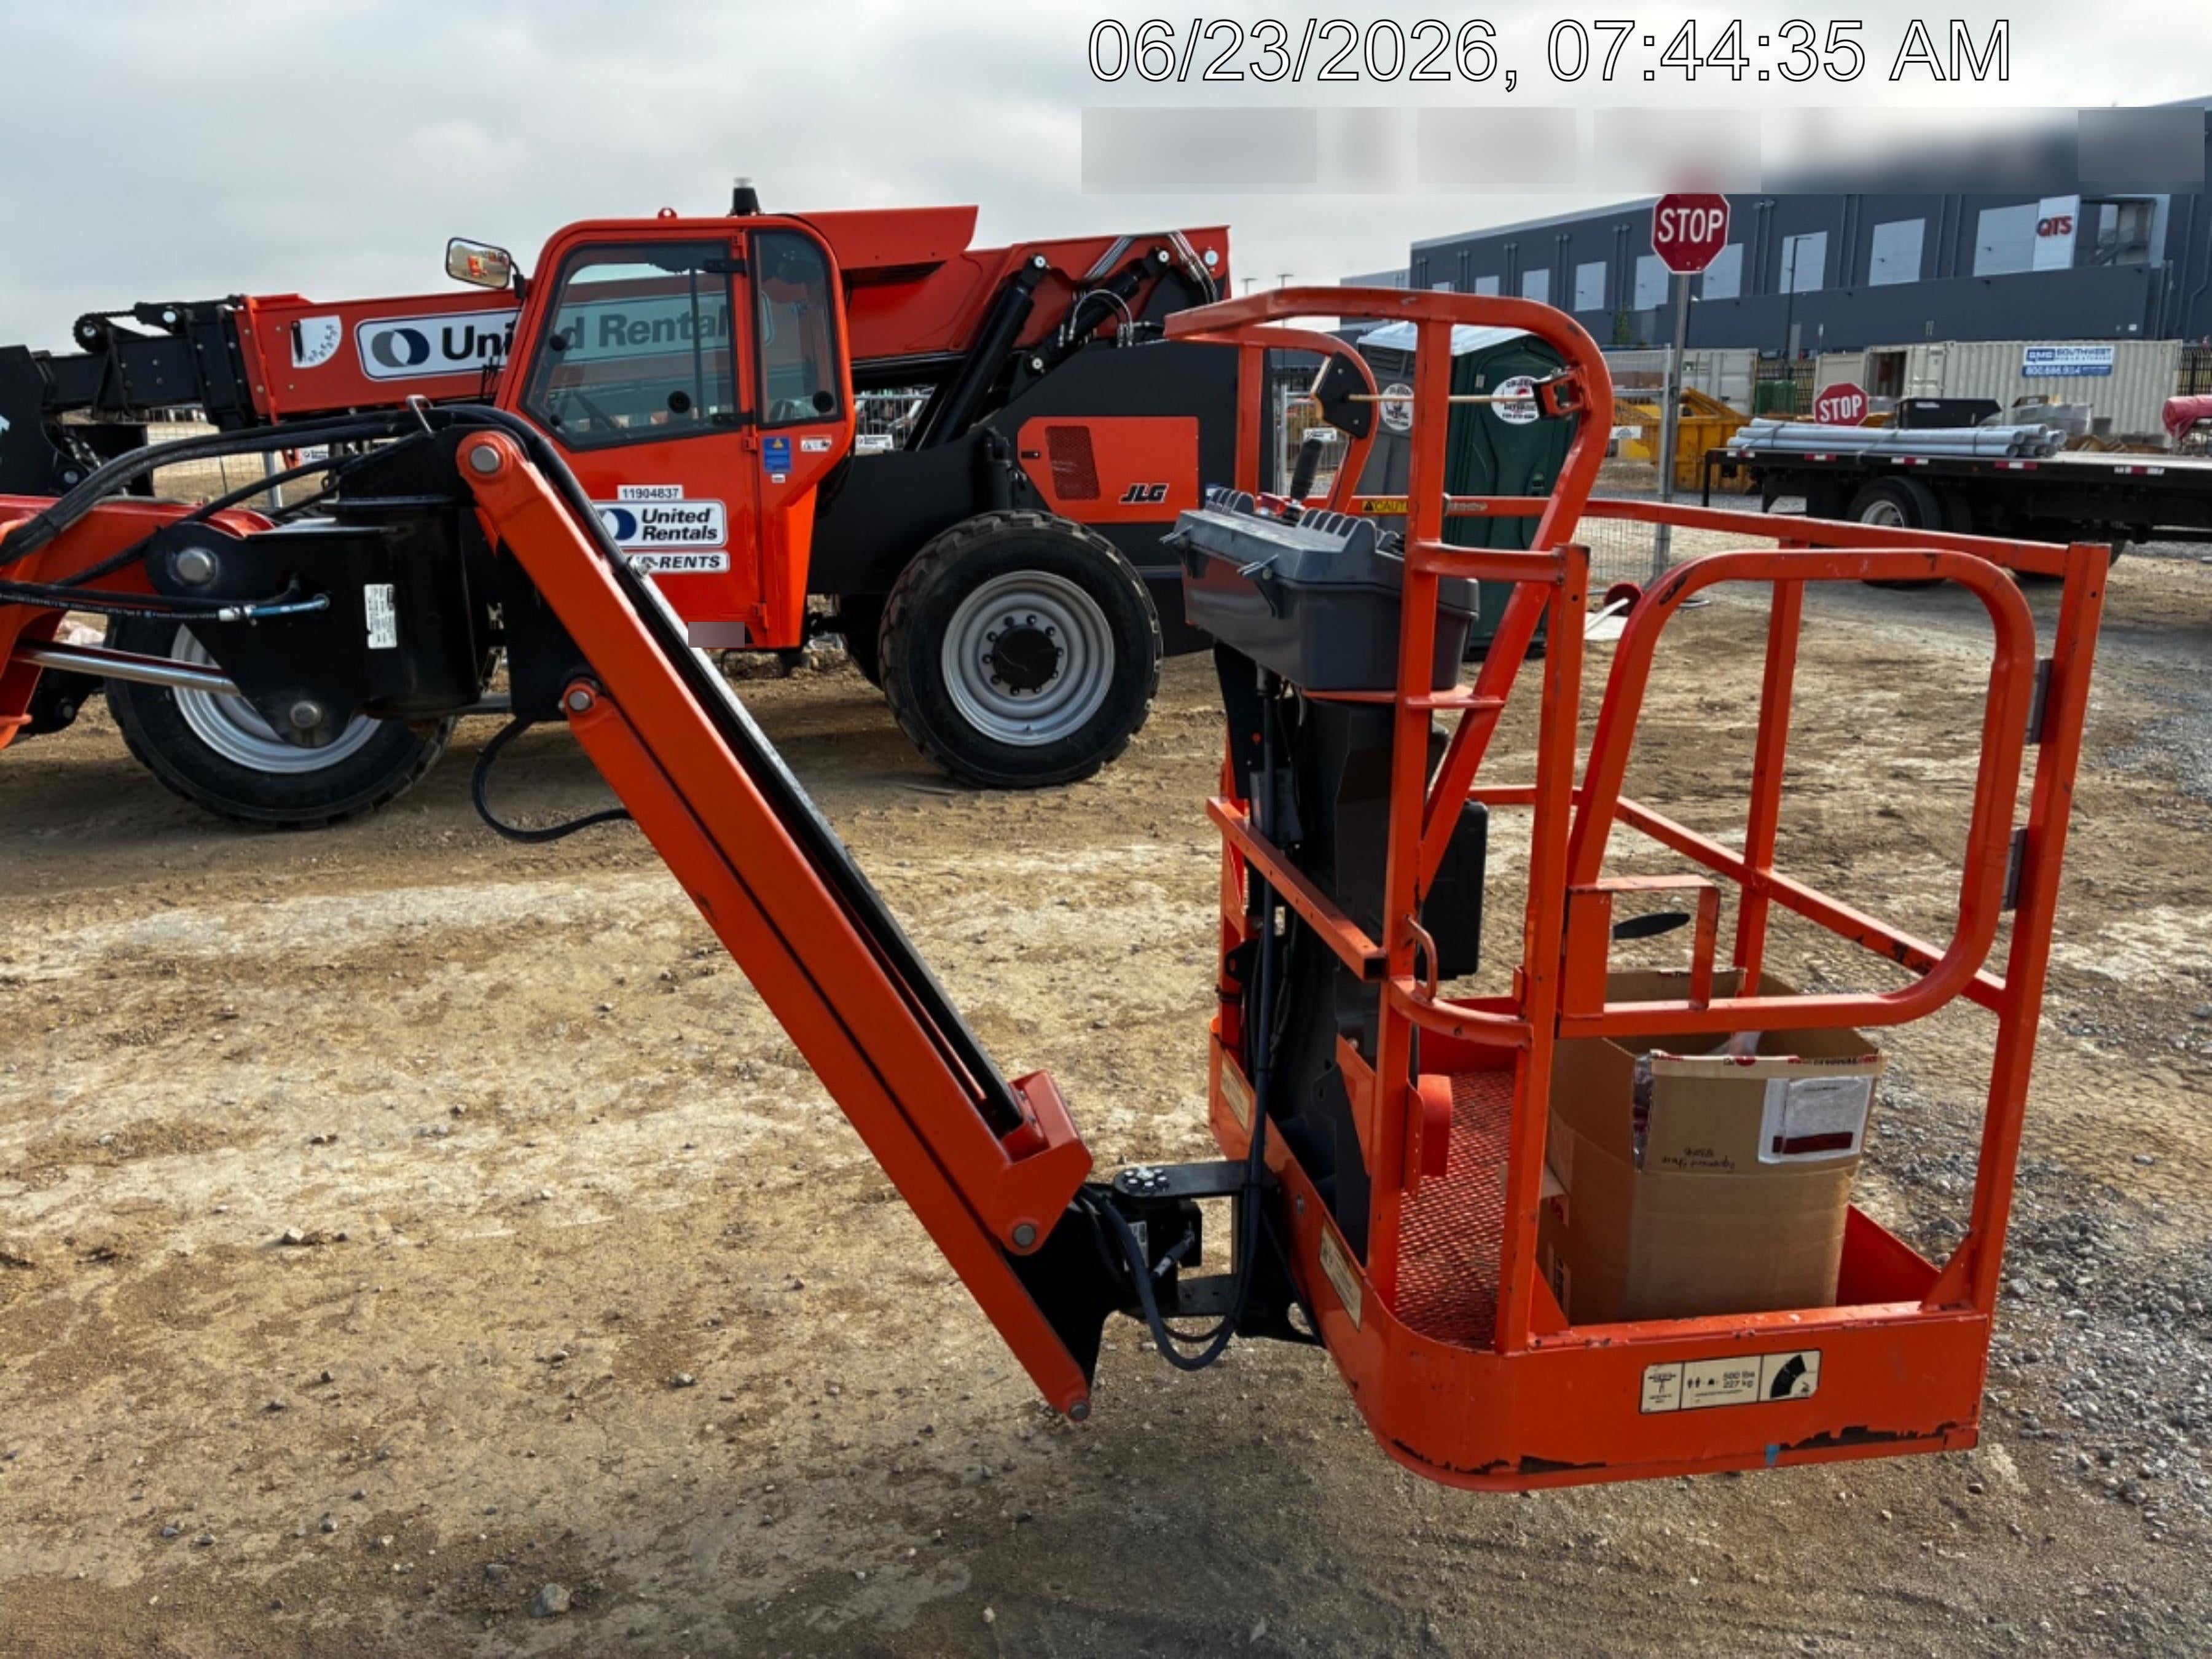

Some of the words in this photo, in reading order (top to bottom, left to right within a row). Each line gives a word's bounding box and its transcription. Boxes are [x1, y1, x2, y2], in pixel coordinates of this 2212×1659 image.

[1657, 208, 1724, 243] STOP
[2036, 215, 2073, 237] QTS
[599, 305, 729, 348] Rental
[1819, 394, 1862, 423] STOP
[622, 488, 679, 499] 11904837
[1120, 483, 1168, 503] JLG
[641, 508, 711, 524] United
[641, 525, 718, 541] Rentals
